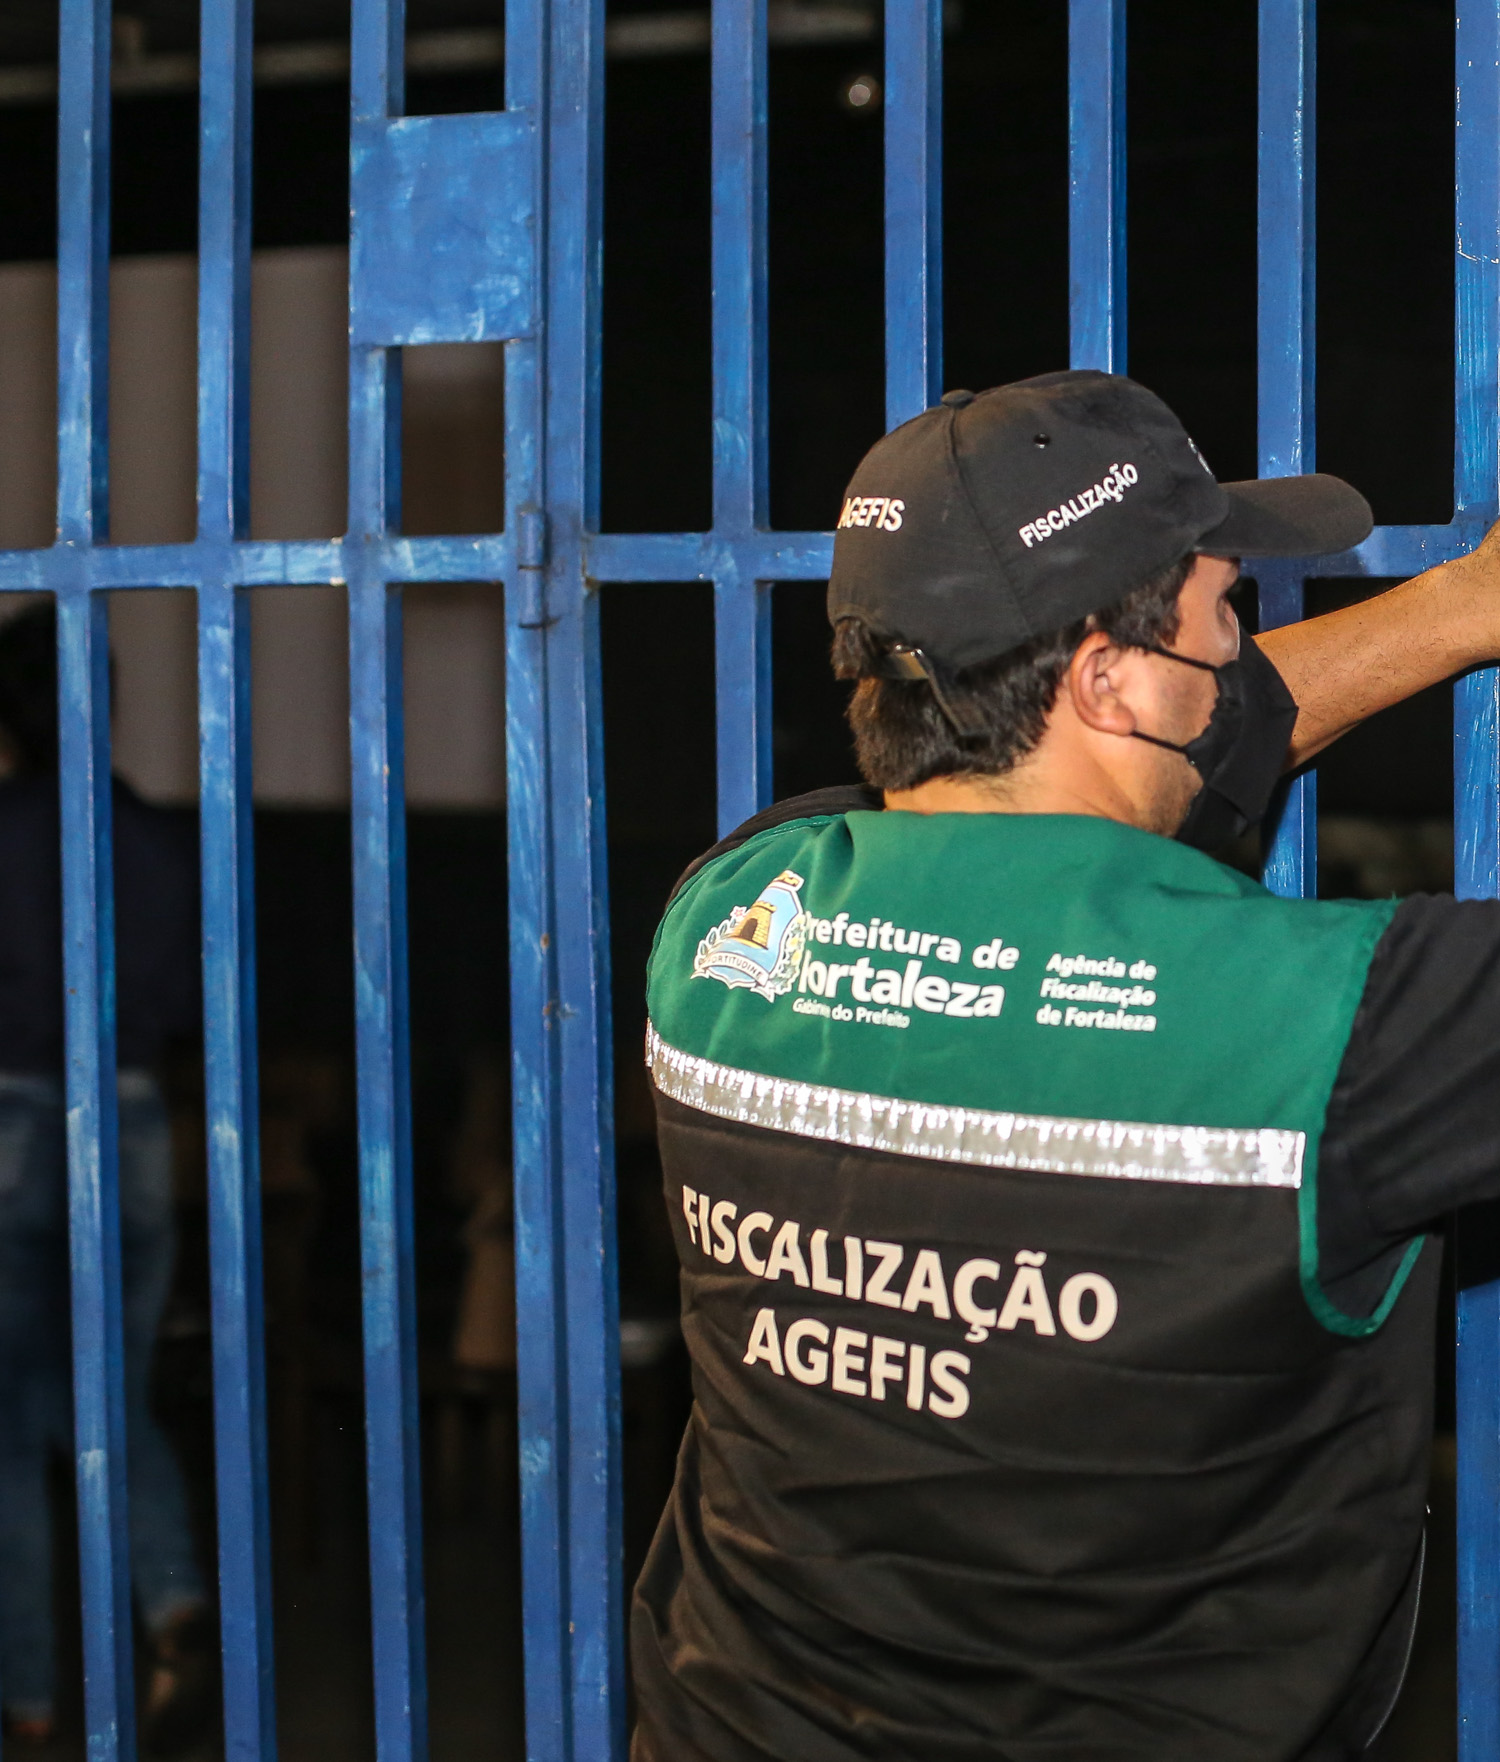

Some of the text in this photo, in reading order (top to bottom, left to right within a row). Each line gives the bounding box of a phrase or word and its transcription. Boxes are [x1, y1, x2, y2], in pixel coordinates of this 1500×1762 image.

[837, 496, 905, 532] AGEFIS
[1018, 462, 1138, 548] FISCALIZAÇÃO
[805, 909, 1020, 972] refeitura de
[1045, 953, 1157, 981] Agência de
[1040, 977, 1157, 1009] Fiscalização
[832, 1003, 853, 1022] do
[856, 1006, 911, 1029] Prefeito
[1036, 1003, 1157, 1032] de Fortaleza
[682, 1184, 1118, 1343] FISCALIZAÇÃO
[743, 1308, 971, 1419] AGEFIS
